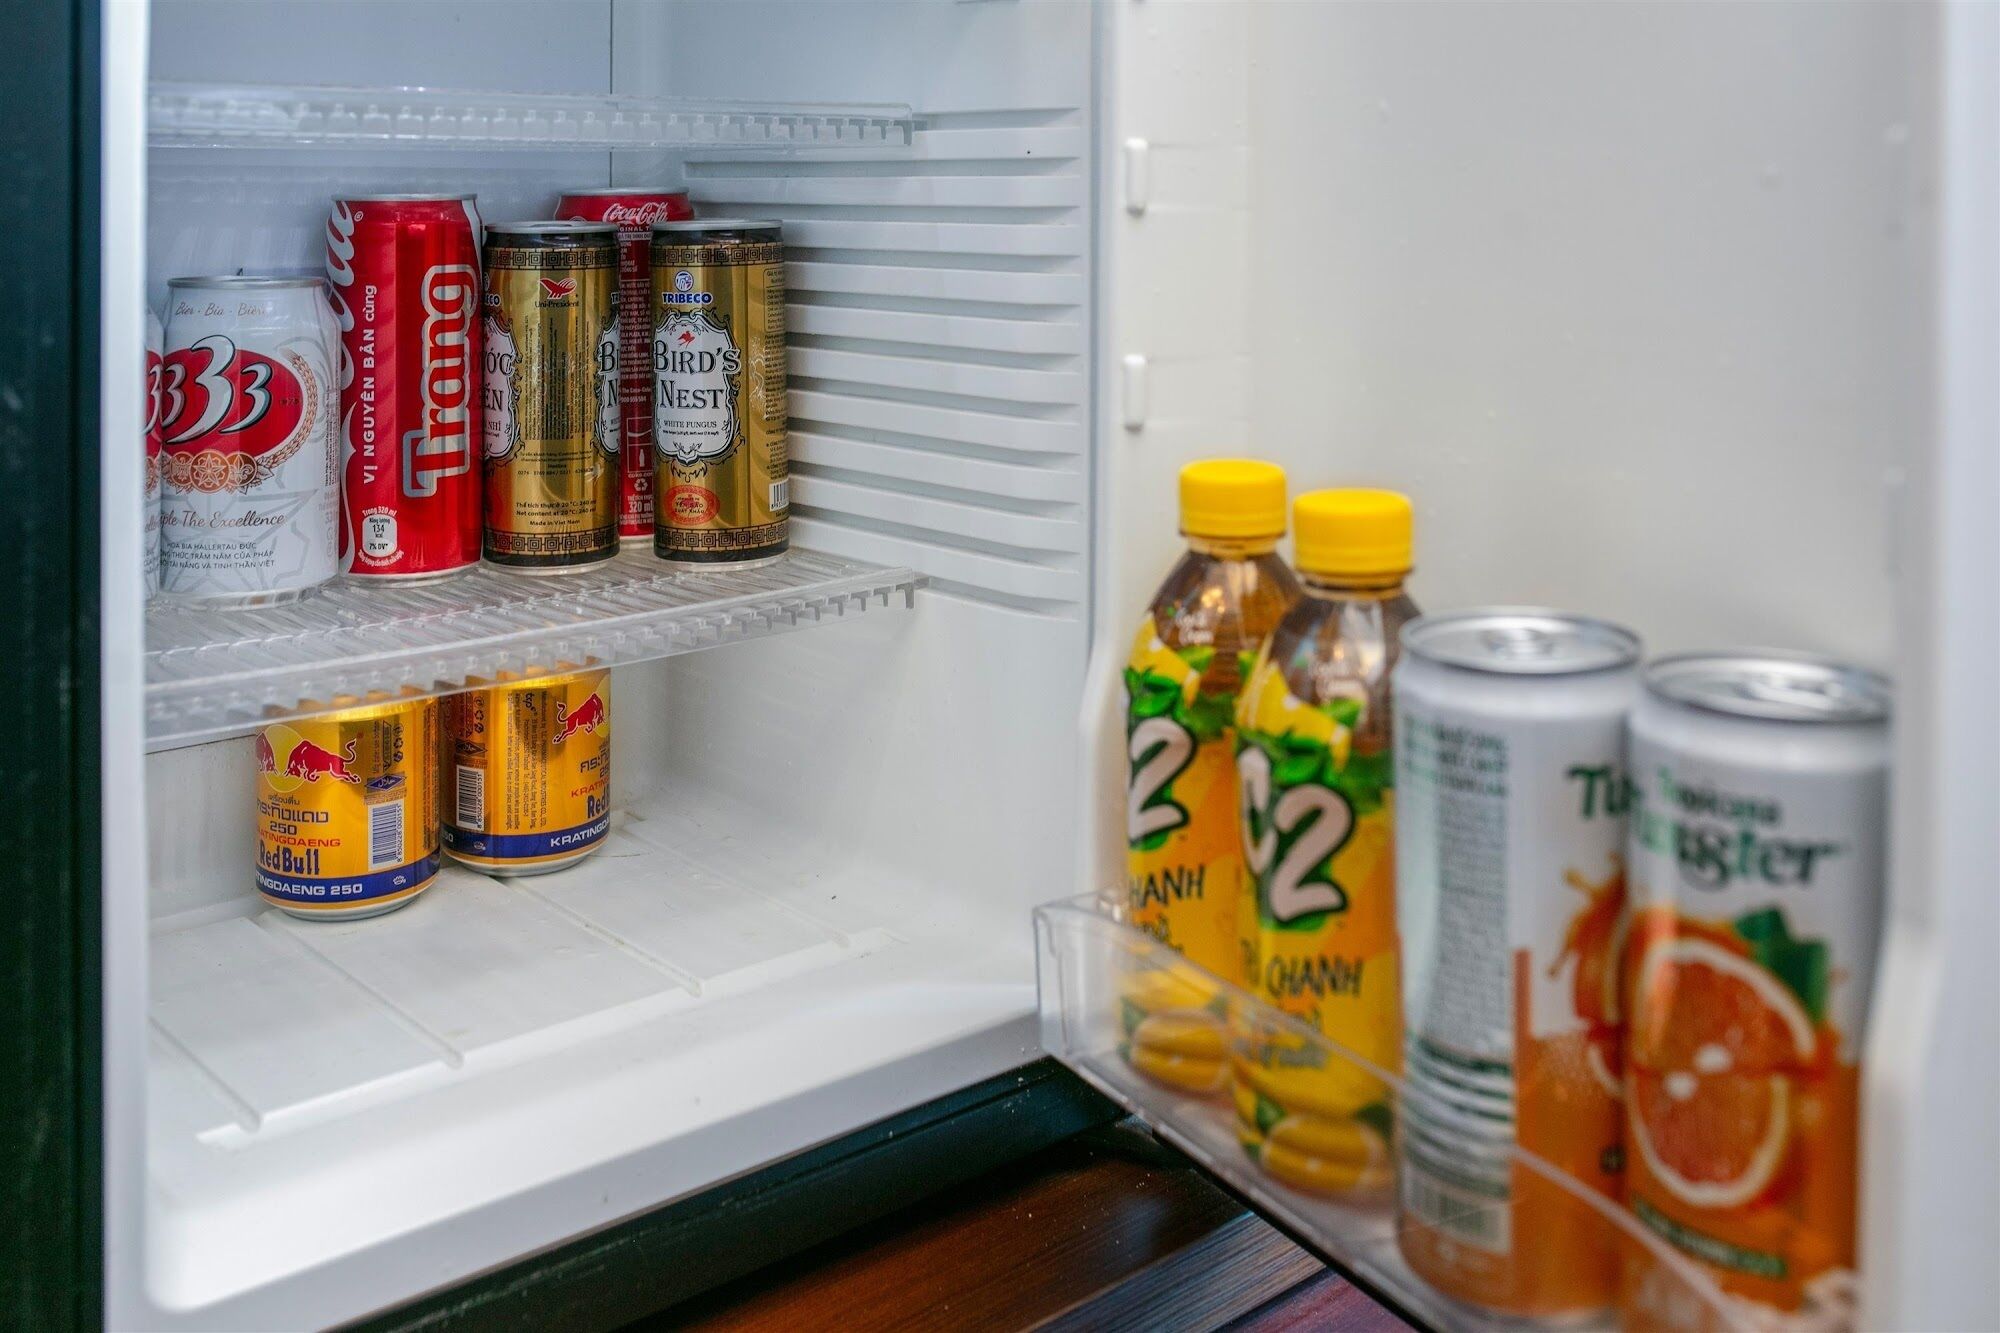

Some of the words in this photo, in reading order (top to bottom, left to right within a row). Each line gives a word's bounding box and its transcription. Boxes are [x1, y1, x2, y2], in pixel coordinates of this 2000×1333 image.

[602, 202, 668, 224] Coca-Cola
[365, 284, 377, 323] cùng
[662, 293, 712, 304] TRIBECO
[359, 329, 375, 369] BẢN
[654, 340, 741, 374] BIRD'S
[404, 265, 478, 496] Trang
[660, 380, 725, 409] NEST
[362, 377, 375, 457] NGUYÊN
[664, 420, 684, 428] WHITE
[363, 464, 378, 484] VỊ
[182, 510, 206, 527] The
[210, 510, 285, 528] Excellence
[629, 501, 642, 513] 320
[372, 524, 385, 533] 134
[1128, 716, 1196, 846] 2
[259, 829, 341, 847] ATINGDAENG
[270, 820, 297, 835] 250
[1237, 745, 1353, 924] C2
[256, 872, 326, 896] TINGDAENG
[330, 883, 363, 896] 250
[1128, 863, 1206, 909] HANH
